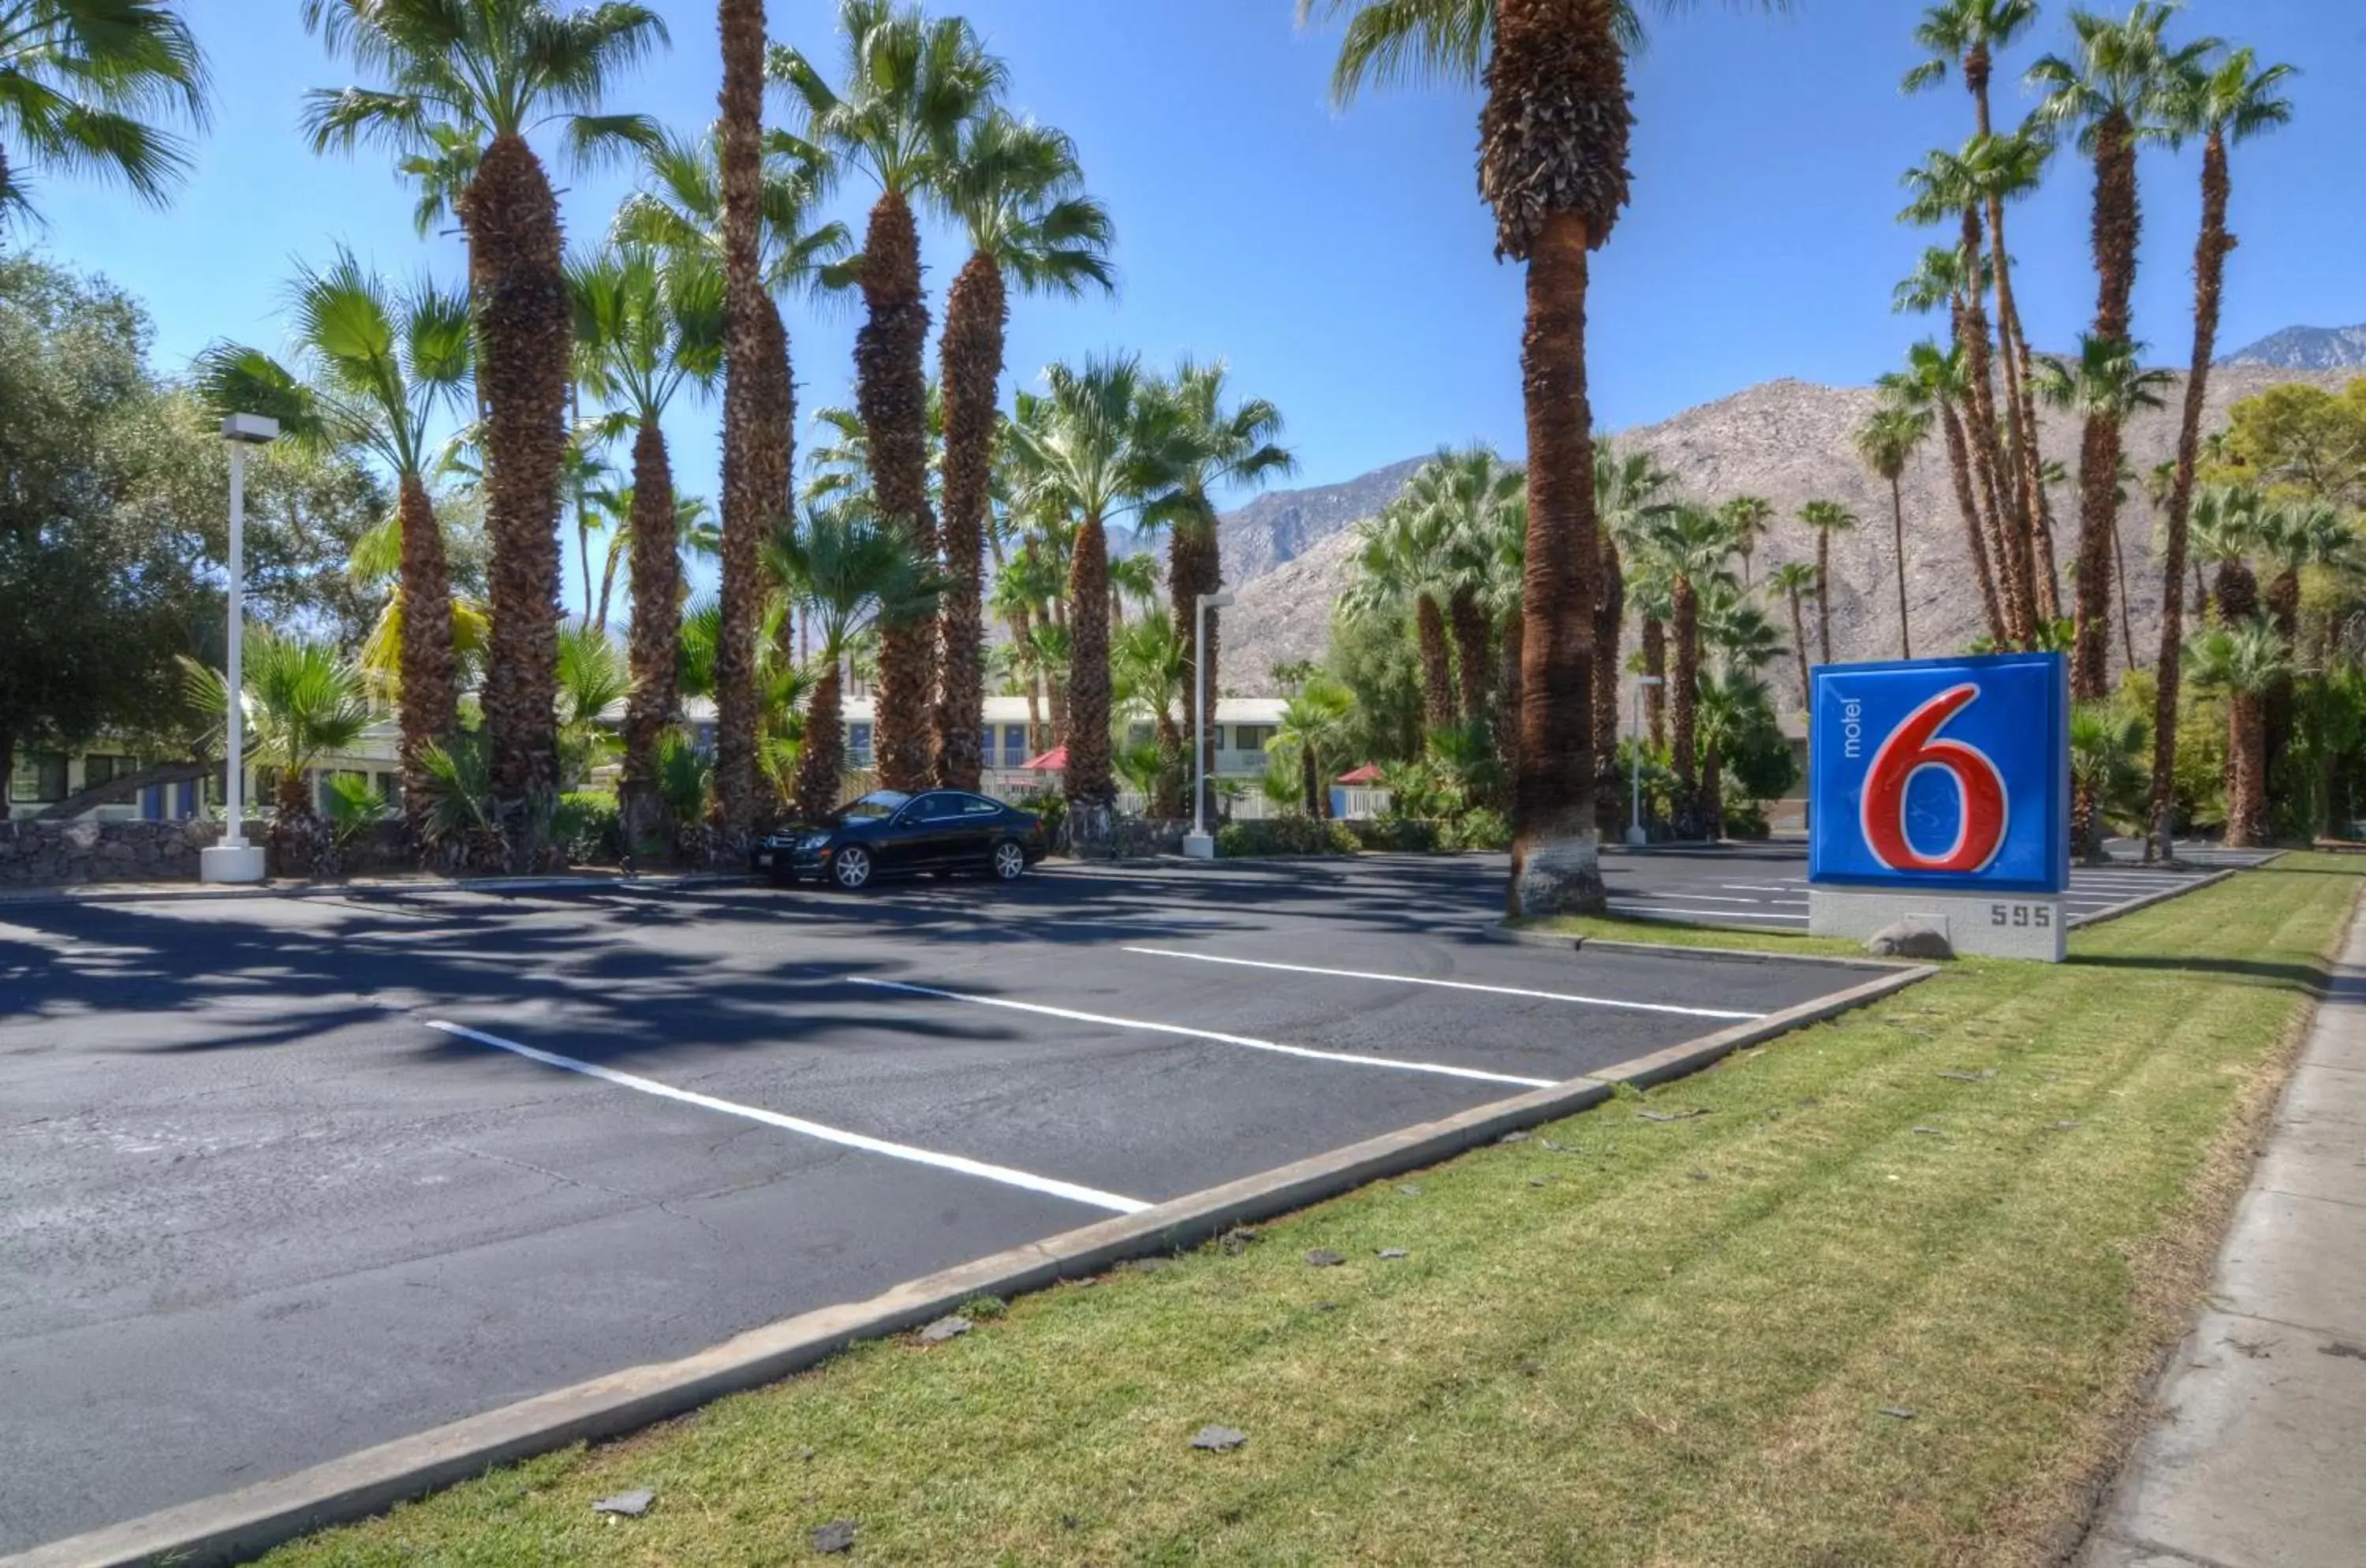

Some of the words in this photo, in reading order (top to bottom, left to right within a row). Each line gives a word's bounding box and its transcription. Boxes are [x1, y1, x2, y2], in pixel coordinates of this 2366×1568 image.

[1841, 699, 1860, 759] motel
[1860, 682, 2009, 872] 6
[1991, 905, 2051, 928] 595
